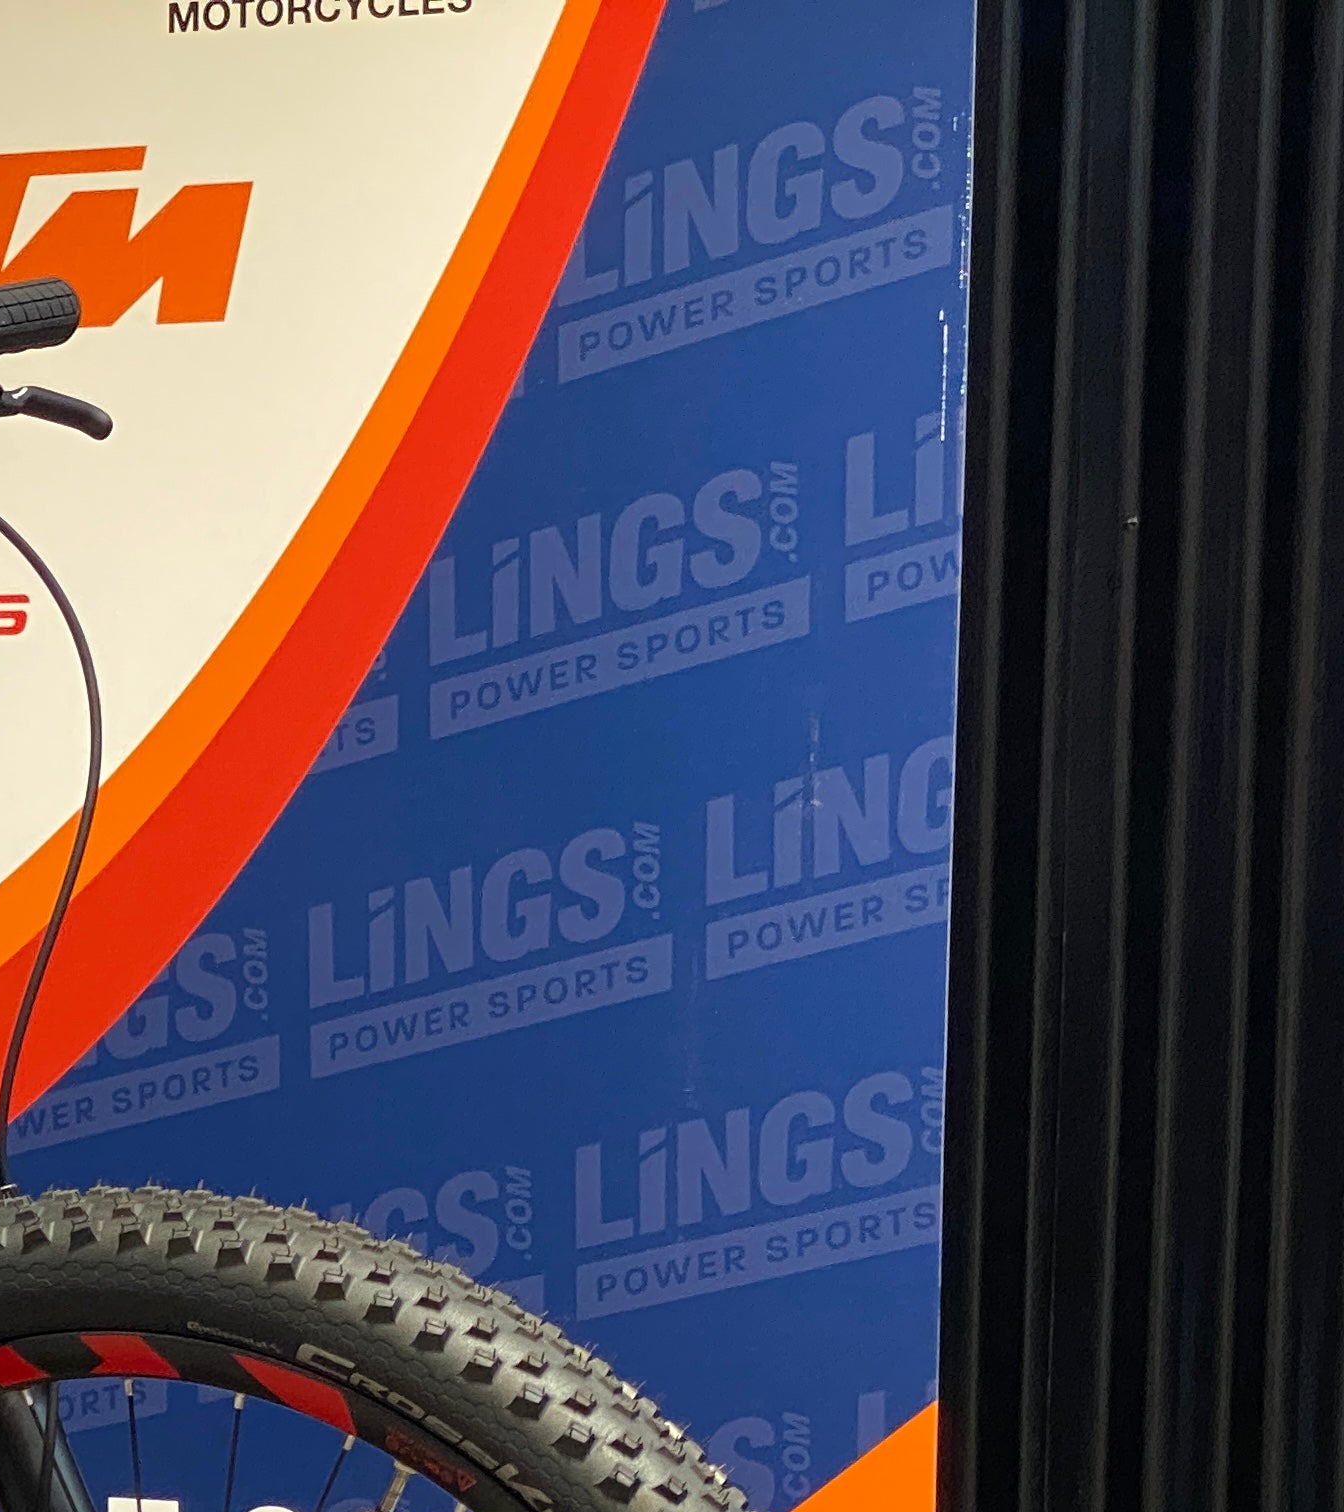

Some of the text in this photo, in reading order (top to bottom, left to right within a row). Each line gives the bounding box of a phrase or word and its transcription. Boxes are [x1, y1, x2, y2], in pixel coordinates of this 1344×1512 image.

[579, 229, 928, 362] POWER SPORTS
[451, 600, 785, 719] POWER SPORTS
[728, 896, 883, 959] POWER
[329, 957, 648, 1061] POWER SPORTS
[112, 1055, 258, 1114] SPORTS
[597, 1202, 935, 1301] POWER SPORTS
